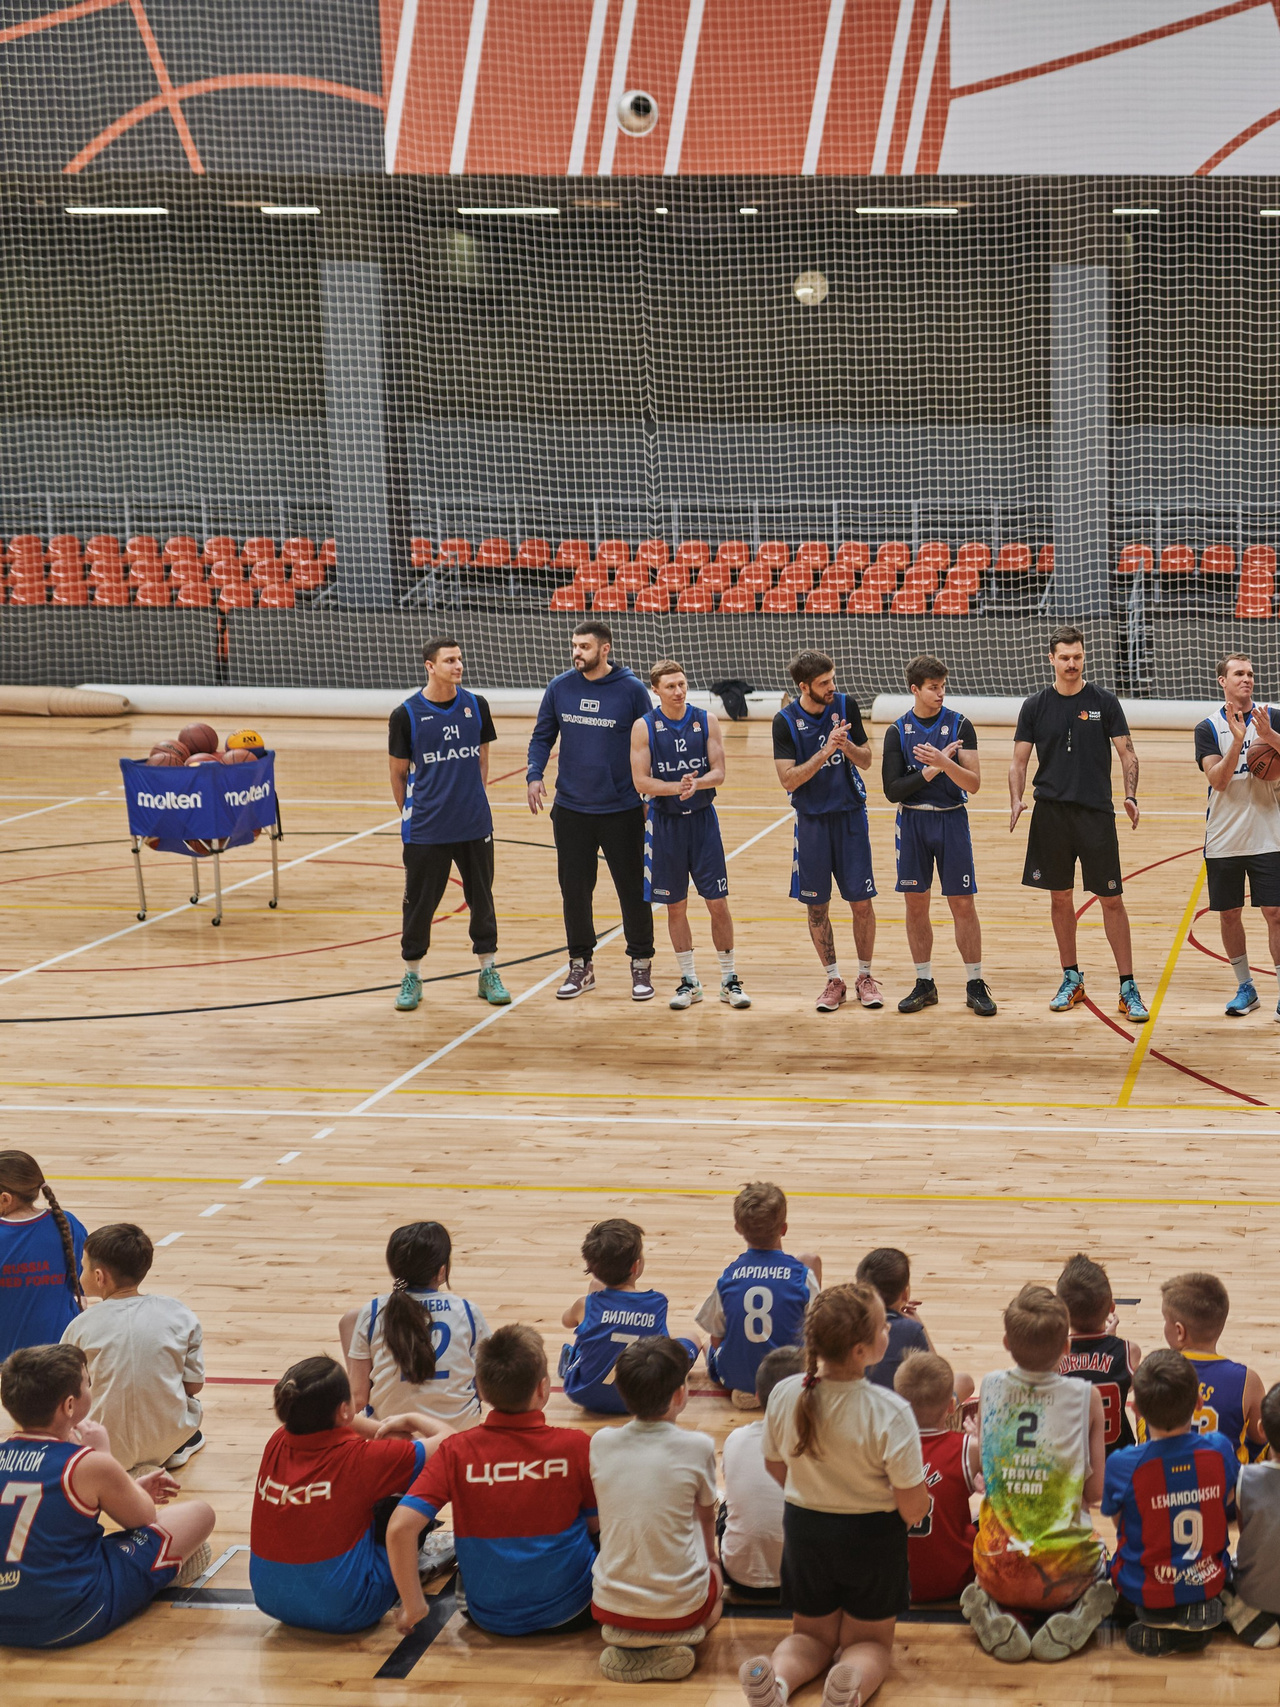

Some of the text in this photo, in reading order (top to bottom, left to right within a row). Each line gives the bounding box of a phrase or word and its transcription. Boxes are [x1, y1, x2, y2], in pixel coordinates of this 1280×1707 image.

[442, 724, 460, 741] 24
[674, 738, 688, 753] 12
[422, 746, 481, 765] BLACK
[137, 791, 203, 811] molten
[224, 781, 271, 807] molten
[716, 877, 728, 893] 12
[864, 878, 873, 892] 2
[962, 874, 970, 888] 9
[2, 1260, 50, 1276] RUSSIA
[731, 1265, 792, 1281] КАРПАЧЕВ
[25, 1273, 67, 1287] FORCE
[600, 1309, 656, 1329] ВИЛИСОВ
[743, 1285, 774, 1344] 8
[1016, 1411, 1038, 1449] 2
[0, 1445, 49, 1473] ЫЦКОЙ
[1012, 1453, 1038, 1467] THE
[465, 1458, 568, 1486] ЦСКА
[1001, 1467, 1049, 1481] TRAVEL
[257, 1475, 332, 1506] ЦСКА
[1005, 1481, 1043, 1495] TEAM
[1150, 1485, 1221, 1510] LEWANDOWSKI
[0, 1480, 44, 1563] 7
[1173, 1508, 1204, 1561] 9
